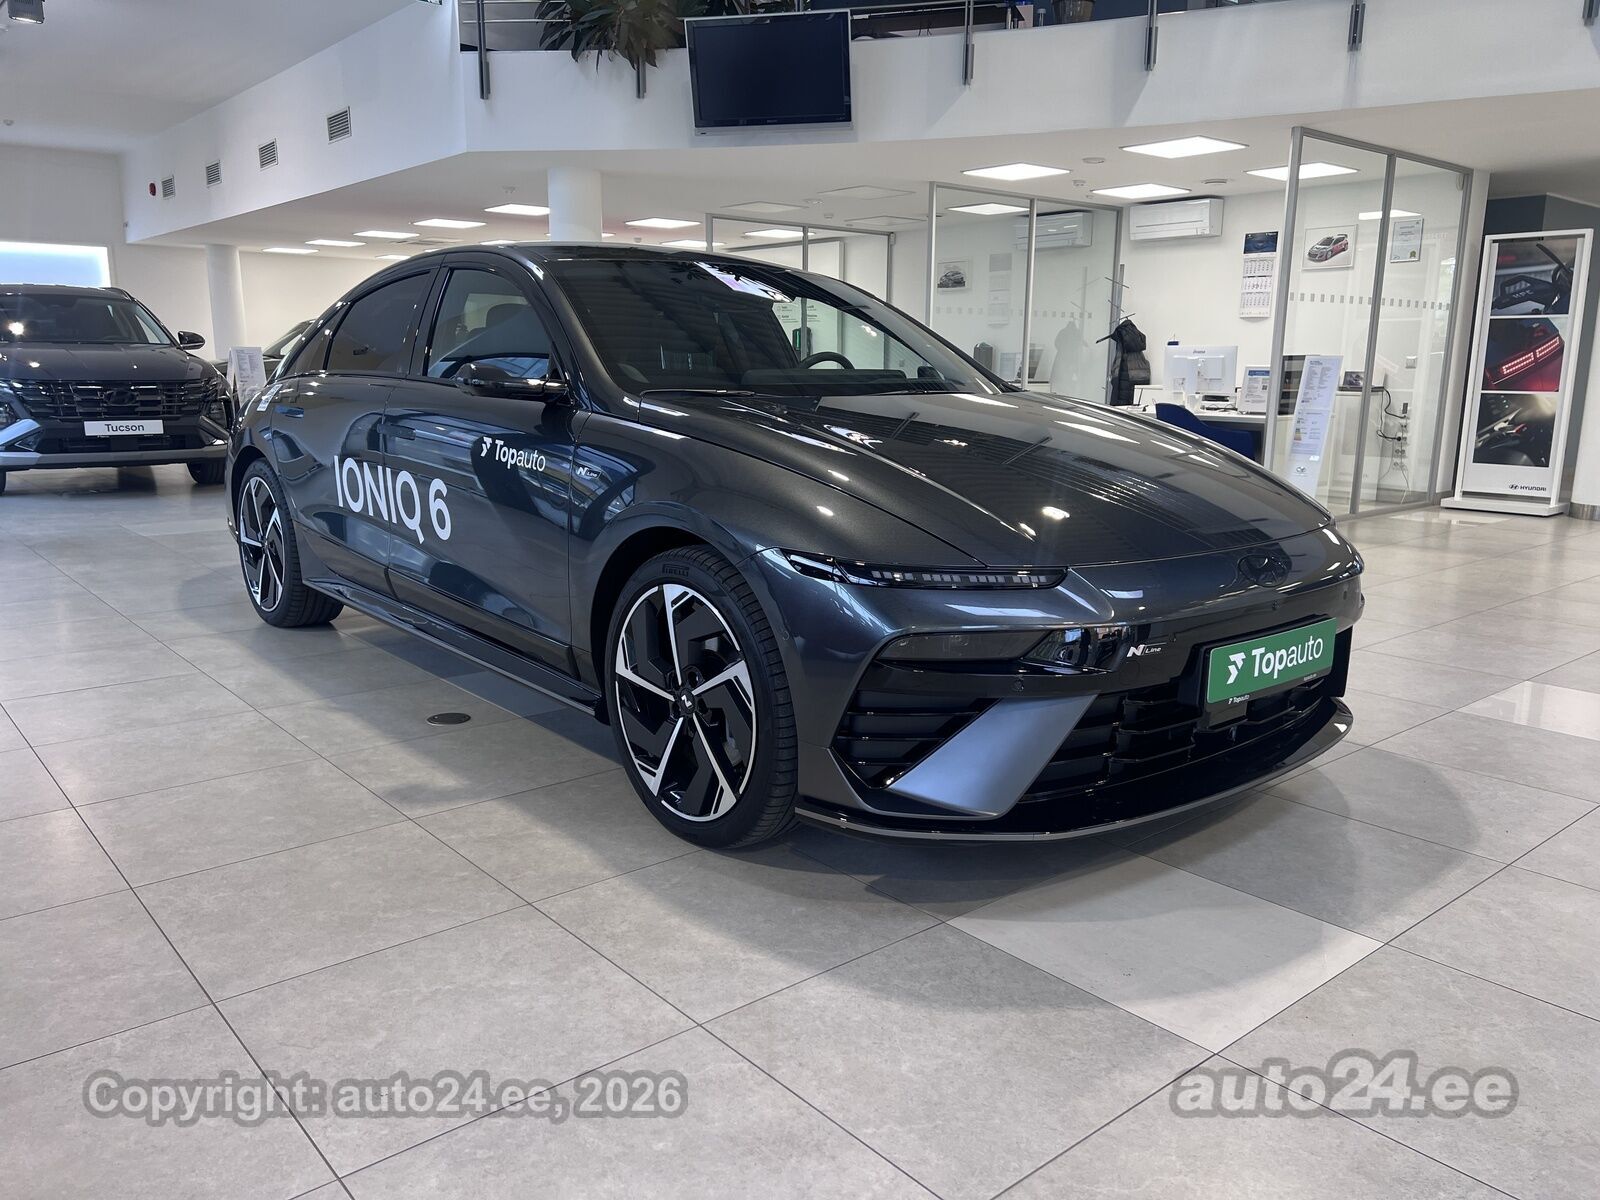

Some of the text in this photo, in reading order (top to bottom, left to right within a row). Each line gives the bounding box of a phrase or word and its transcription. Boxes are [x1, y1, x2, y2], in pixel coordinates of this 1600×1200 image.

[104, 423, 145, 433] Tucson
[495, 438, 547, 473] Topauto
[1520, 484, 1547, 492] HYUNDAI
[332, 454, 451, 545] IONIQ 6
[662, 563, 690, 577] PIRELLI
[1126, 644, 1146, 658] N
[1251, 635, 1324, 680] Topauto
[1232, 694, 1250, 704] Topauto
